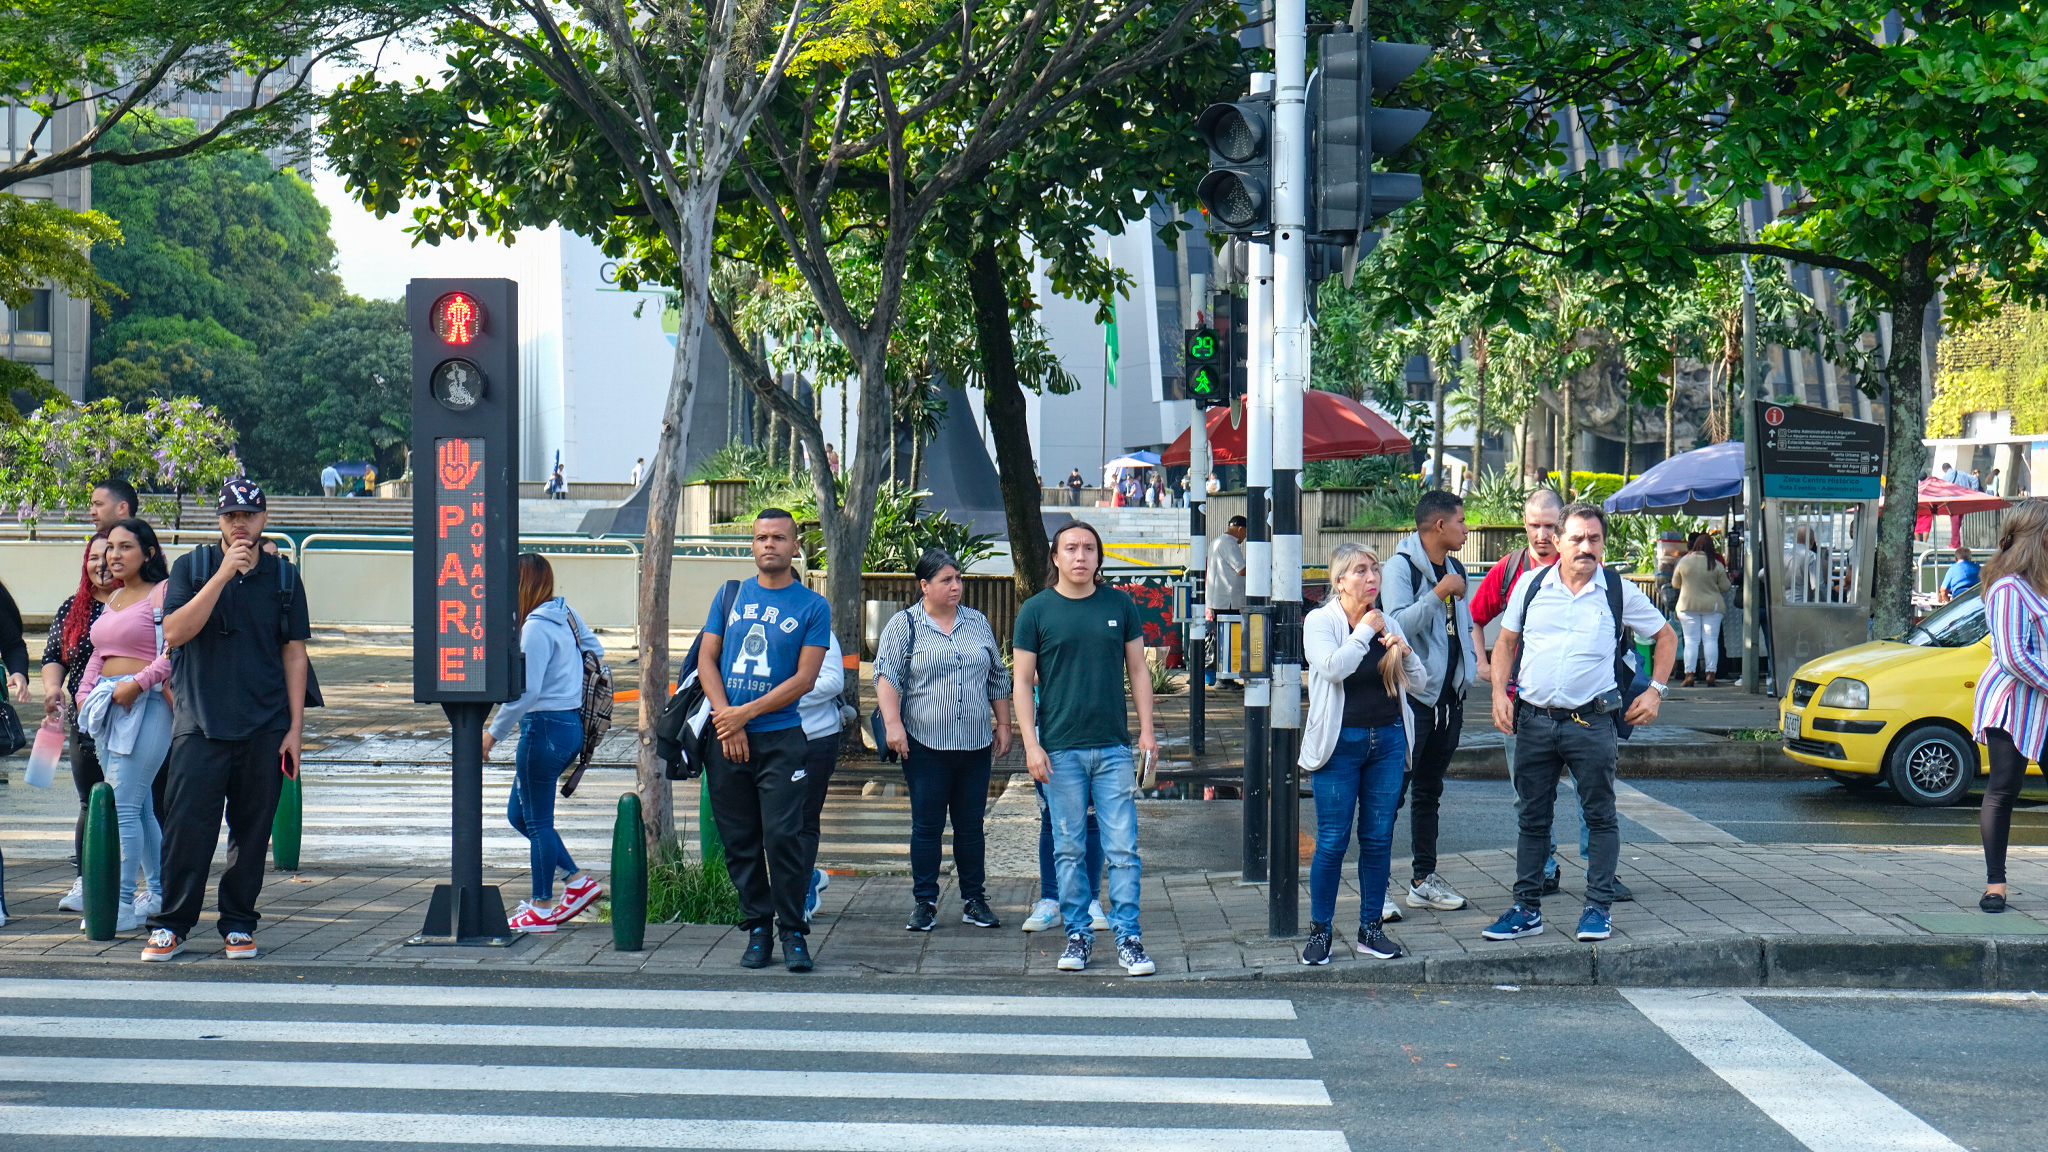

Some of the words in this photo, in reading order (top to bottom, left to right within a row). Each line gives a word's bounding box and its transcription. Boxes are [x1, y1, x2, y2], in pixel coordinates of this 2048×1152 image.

[1192, 336, 1213, 357] 29
[438, 505, 470, 681] PARE
[471, 492, 484, 660] NOVACIÓN
[728, 603, 798, 634] AERO
